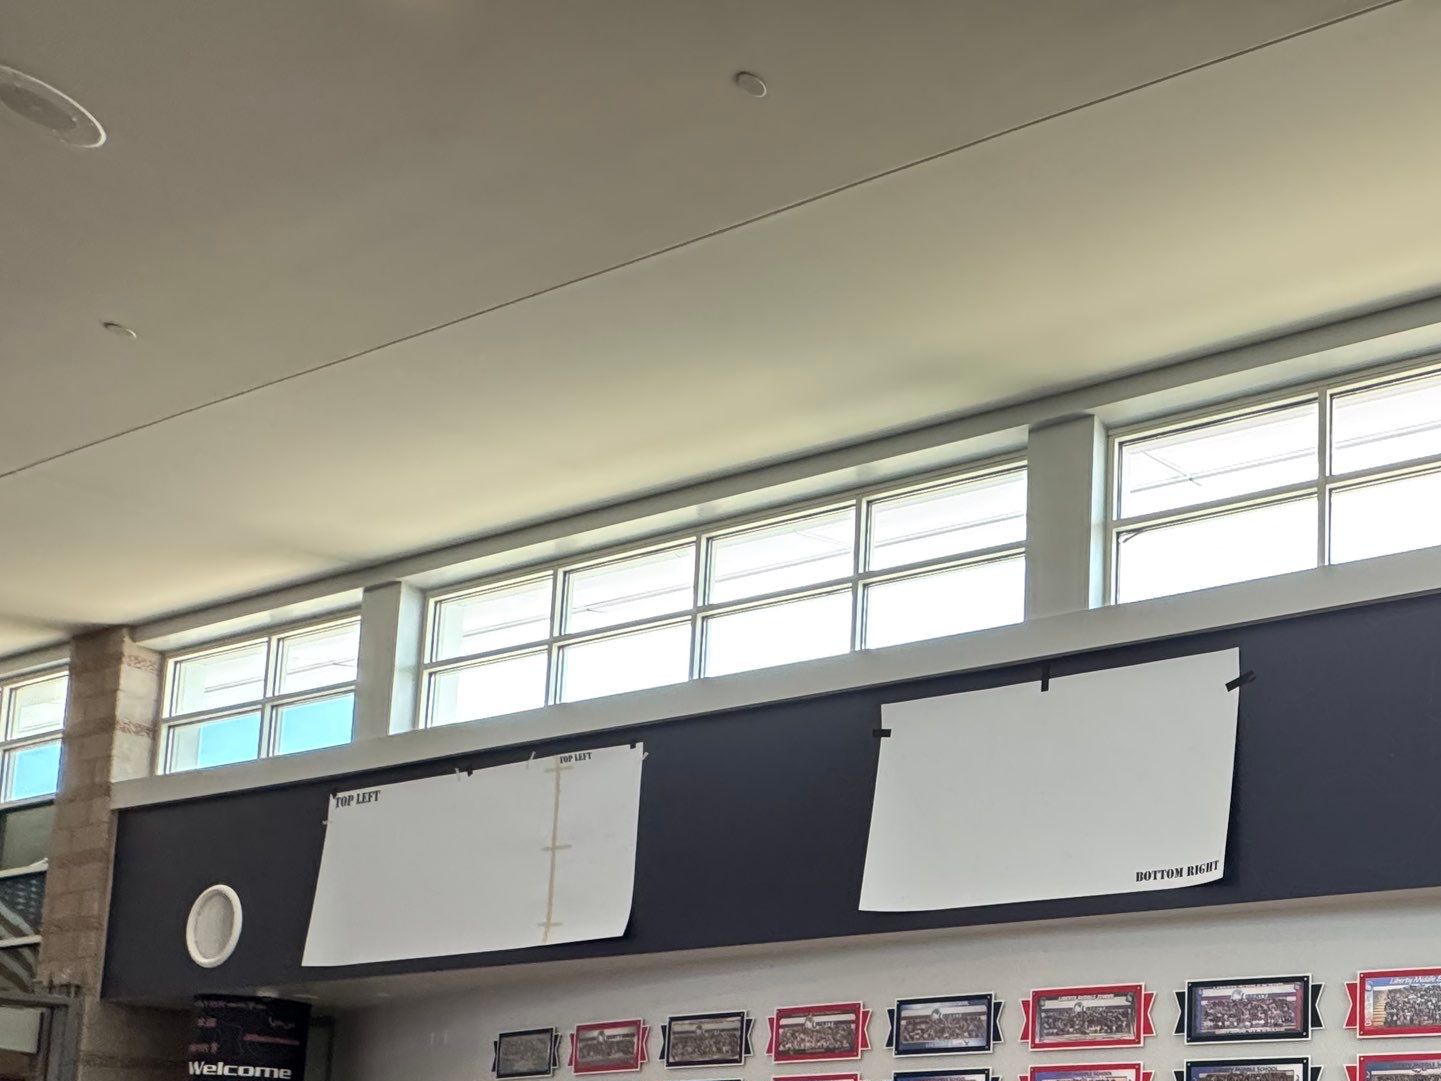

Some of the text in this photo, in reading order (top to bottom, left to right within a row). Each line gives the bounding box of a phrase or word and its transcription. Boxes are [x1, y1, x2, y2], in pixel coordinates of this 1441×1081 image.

[560, 751, 592, 764] TOP LEFT
[336, 790, 381, 808] TOP LEFT
[1135, 860, 1219, 882] BOTTOM RIGHT
[188, 1061, 292, 1080] Welcome
